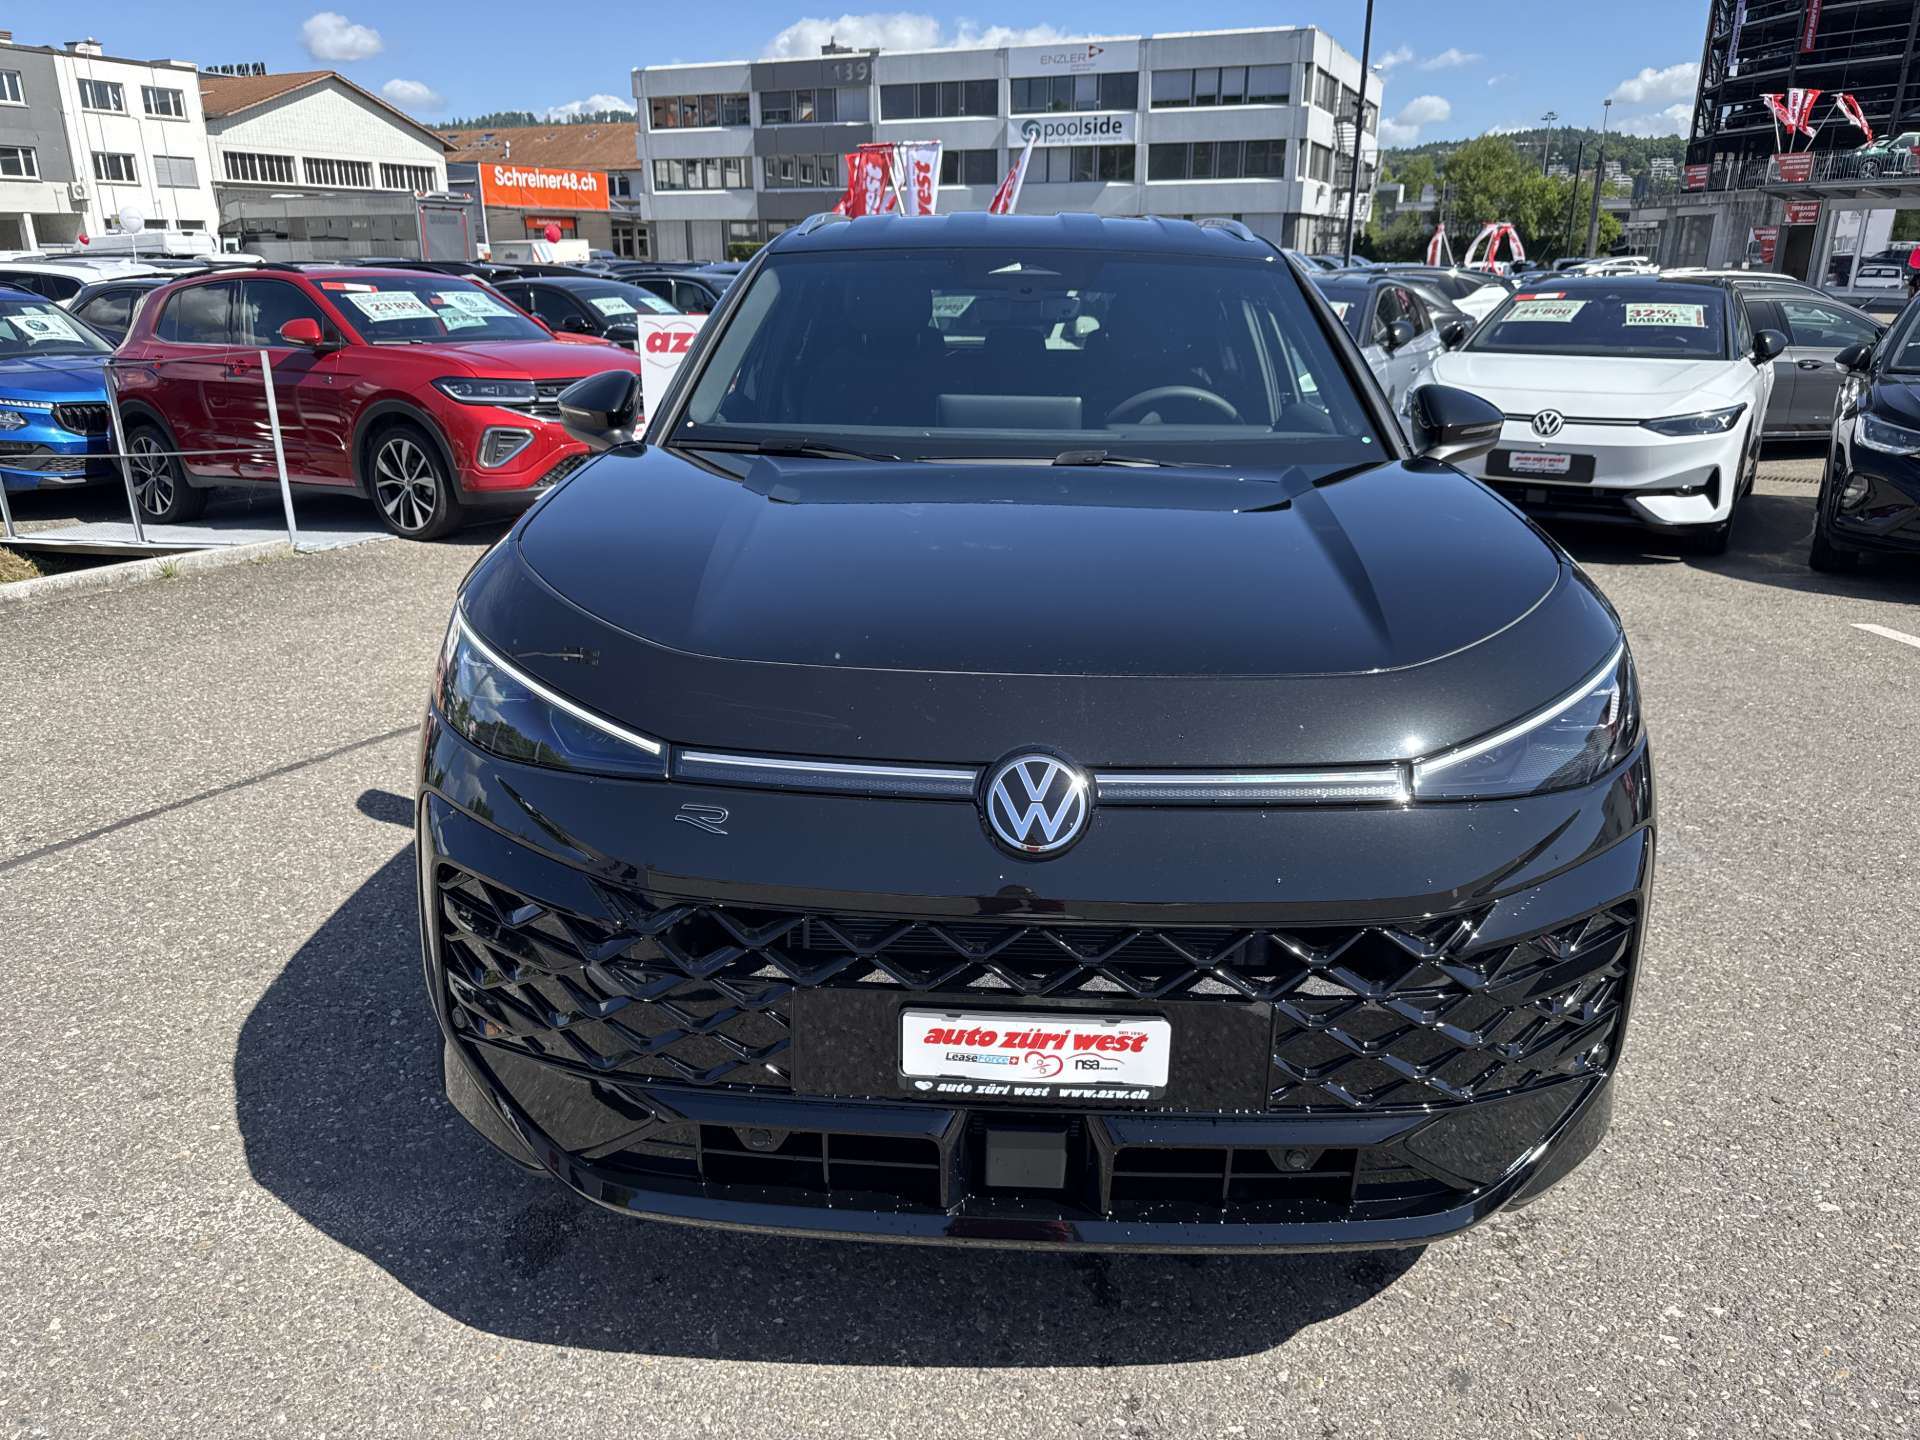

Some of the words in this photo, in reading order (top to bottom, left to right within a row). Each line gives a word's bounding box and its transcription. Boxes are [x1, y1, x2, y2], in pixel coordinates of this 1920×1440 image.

[1040, 53, 1087, 65] ENZLER
[833, 62, 868, 81] 139
[1044, 116, 1123, 143] poolside
[494, 165, 598, 192] Schreiner48.ch
[924, 1026, 998, 1046] auto
[999, 1029, 1072, 1050] züri
[1072, 1032, 1149, 1053] west
[945, 1051, 1009, 1065] LeaseForce
[1075, 1059, 1100, 1071] nsa
[937, 1082, 972, 1093] auto
[974, 1083, 1011, 1095] züri
[1013, 1086, 1050, 1097] west
[1059, 1087, 1150, 1100] www.azw.ch
